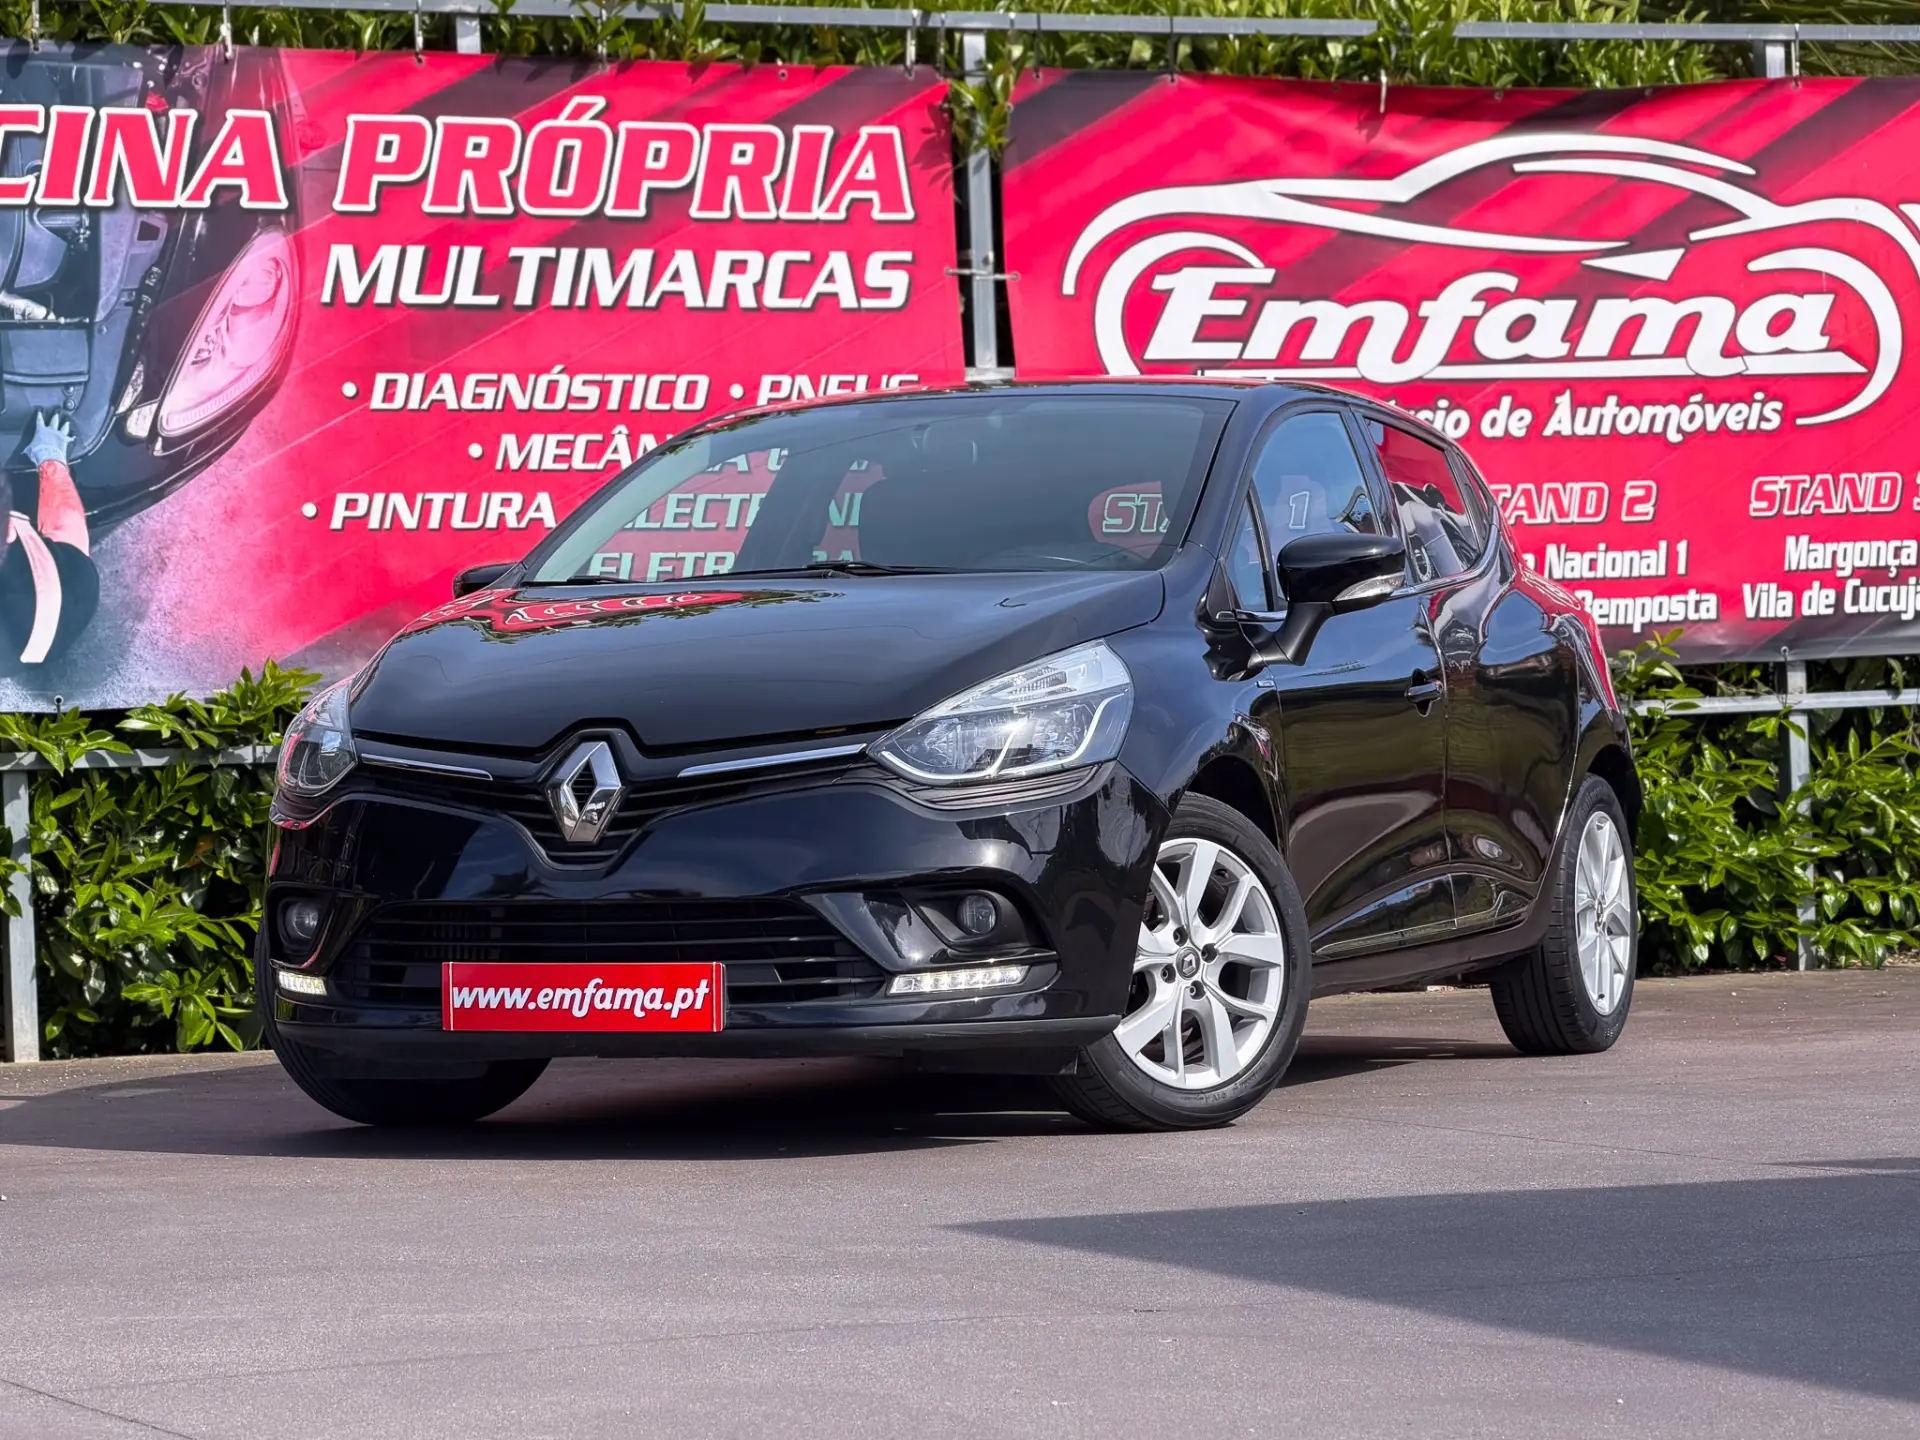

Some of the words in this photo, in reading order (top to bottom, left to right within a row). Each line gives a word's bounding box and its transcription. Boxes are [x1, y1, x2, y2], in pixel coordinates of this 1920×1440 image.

[332, 95, 916, 221] PRÓPRIA
[321, 244, 913, 309] MULTIMARCAS
[1144, 266, 1834, 383] Emfama
[369, 365, 710, 411] DIAGNÓSTICO
[1480, 396, 1533, 438] de
[329, 492, 558, 530] PINTURA
[1620, 479, 1658, 522] 2
[1749, 472, 1902, 517] STAND
[1542, 540, 1668, 580] Nacional
[1676, 539, 1689, 575] 1
[1784, 534, 1918, 578] Margonça
[1742, 582, 1794, 619] Vila
[1801, 580, 1836, 617] de
[1844, 575, 1920, 621] Cucuj
[452, 977, 710, 1019] www.emfama.pt
